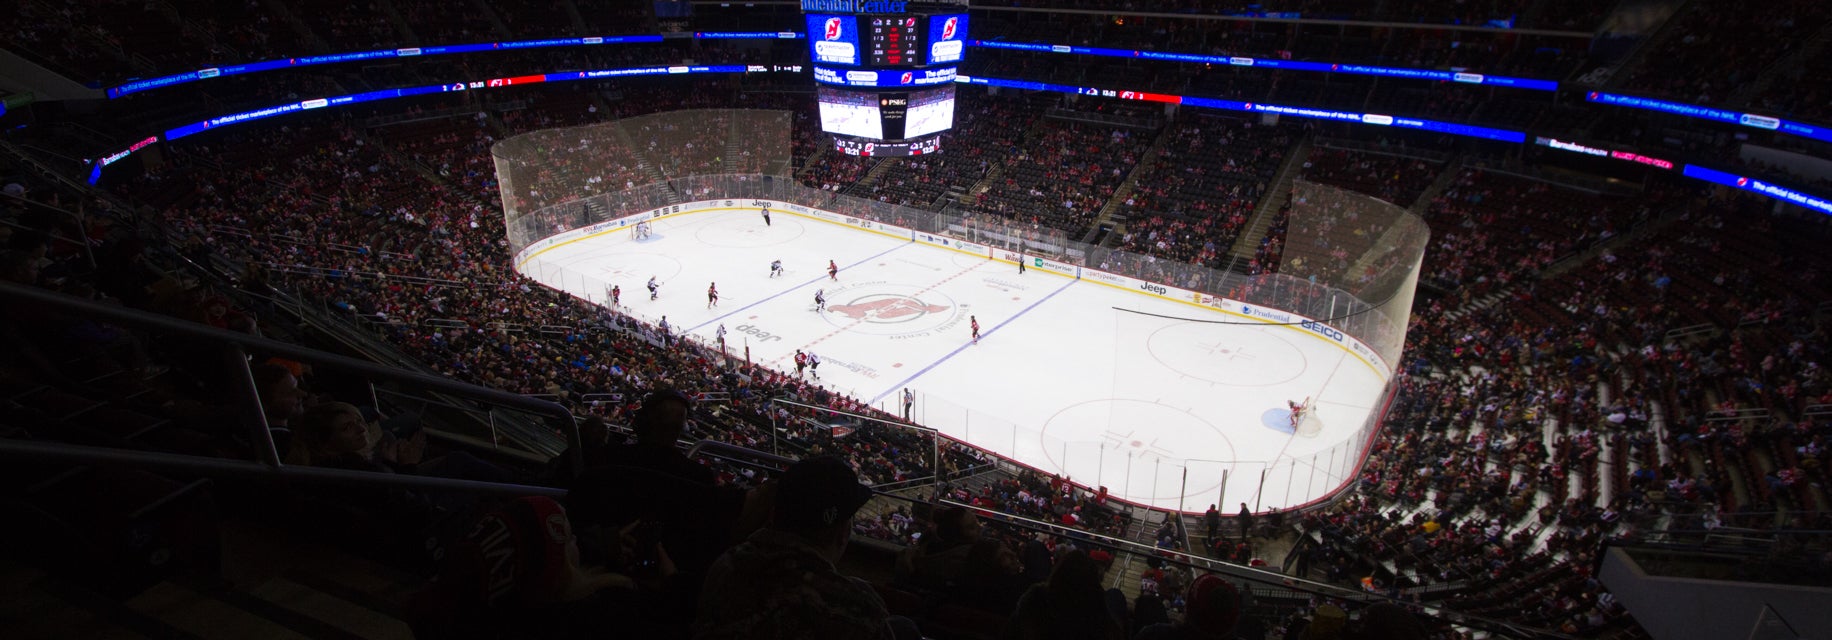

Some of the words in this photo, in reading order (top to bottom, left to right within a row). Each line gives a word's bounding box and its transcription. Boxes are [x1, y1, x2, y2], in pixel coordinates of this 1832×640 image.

[854, 0, 908, 12] Center
[249, 109, 277, 117] marketplace
[1660, 103, 1698, 114] marketplace
[845, 147, 859, 156] 13:21
[1549, 139, 1584, 152] Barnabas
[1753, 181, 1765, 191] The
[1765, 186, 1788, 198] official
[1787, 191, 1807, 203] ticket
[752, 200, 772, 208] Jeep
[1141, 282, 1166, 295] Jeep
[1252, 308, 1290, 322] Prudential
[736, 324, 782, 343] Jeep
[1301, 319, 1343, 342] GEICO
